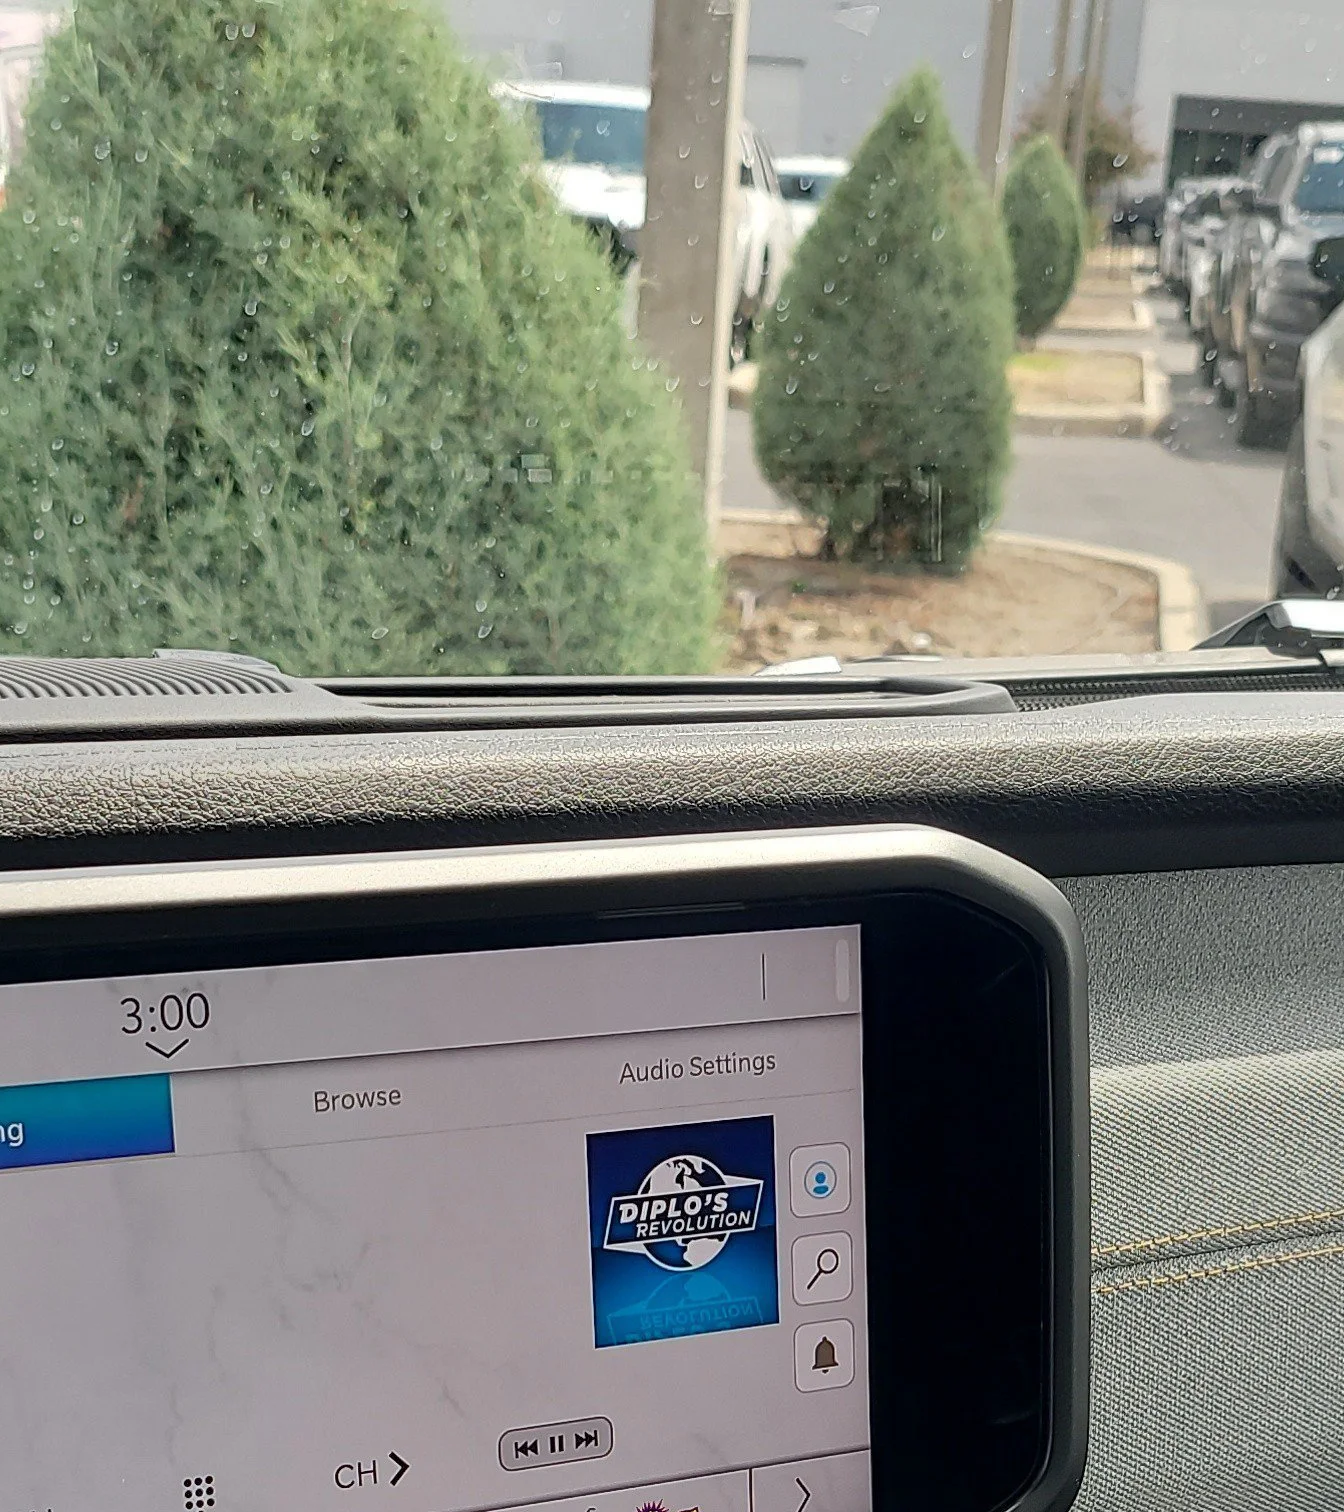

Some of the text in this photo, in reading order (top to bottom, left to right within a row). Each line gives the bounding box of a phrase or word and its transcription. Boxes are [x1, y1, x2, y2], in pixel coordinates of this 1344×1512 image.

[120, 992, 210, 1035] 3:00
[619, 1051, 776, 1084] Audio Settings
[314, 1087, 401, 1113] Browse
[619, 1191, 729, 1225] DIPLO'S
[636, 1210, 750, 1237] REVOLUTION
[335, 1460, 379, 1490] CH
